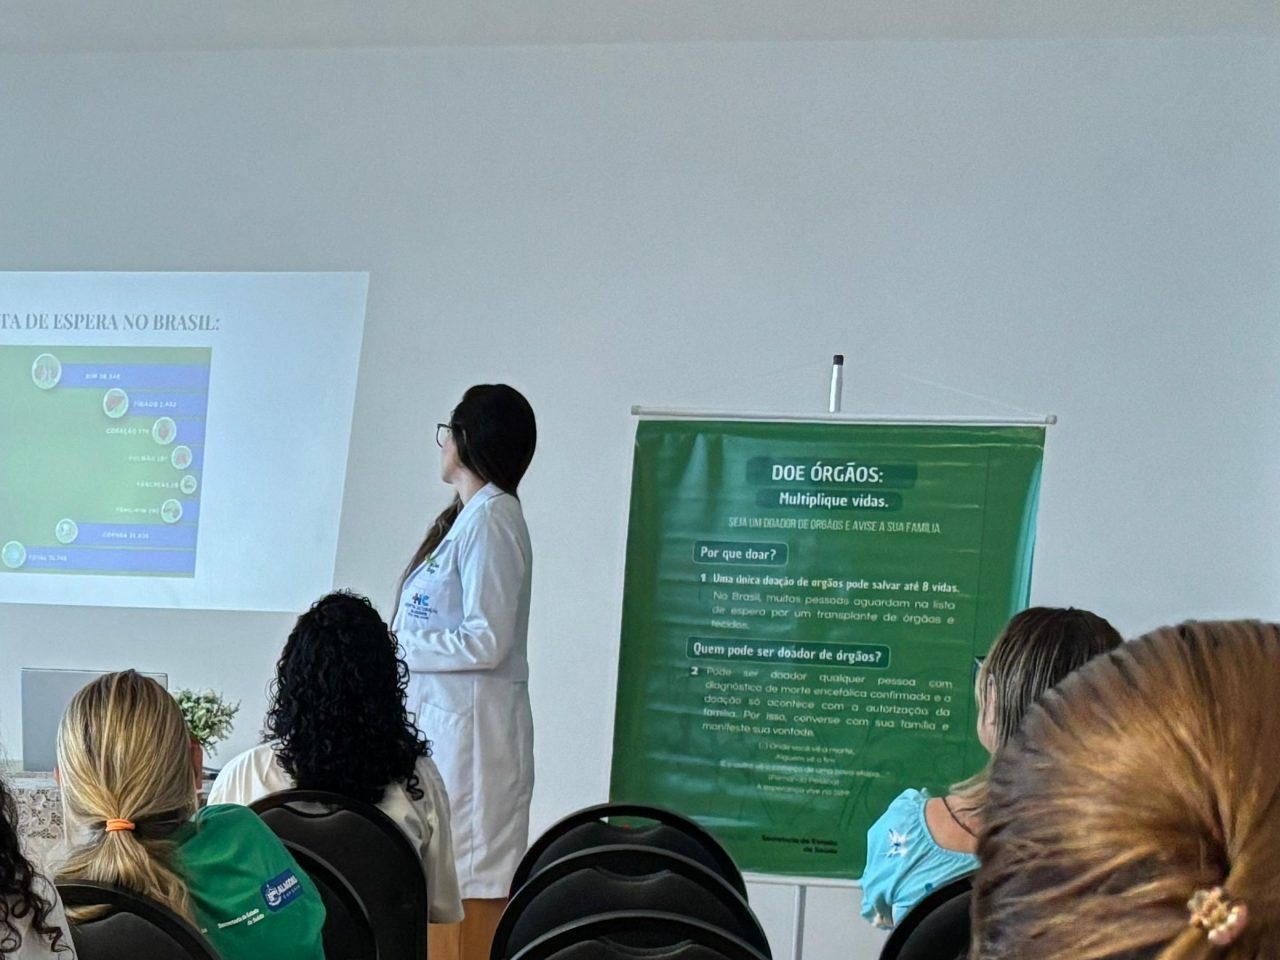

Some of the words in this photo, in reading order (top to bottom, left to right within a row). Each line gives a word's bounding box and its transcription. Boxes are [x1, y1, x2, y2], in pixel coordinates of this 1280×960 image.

[25, 313, 48, 330] DE
[53, 313, 118, 330] ESPERA
[122, 313, 149, 331] NO
[152, 314, 221, 331] BRASIL:
[771, 464, 806, 482] DOE
[810, 461, 884, 483] ÓRGÃOS:
[778, 491, 848, 509] Multiplique
[852, 494, 889, 508] vidas.
[728, 517, 748, 528] SEJA
[749, 518, 762, 528] UM
[763, 518, 796, 529] DOADOR
[797, 518, 809, 530] DE
[845, 520, 851, 531] E
[851, 520, 878, 532] AVISE
[878, 521, 885, 532] A
[886, 521, 905, 533] SUA
[700, 547, 719, 558] Por
[722, 549, 742, 561] que
[745, 548, 777, 561] doar?
[700, 573, 707, 582] 1
[713, 573, 733, 584] Uma
[736, 574, 761, 585] única
[763, 574, 794, 587] doação
[797, 576, 809, 587] de
[846, 579, 869, 591] pode
[872, 580, 901, 591] salvar
[903, 581, 919, 592] até
[922, 582, 929, 591] 8
[932, 582, 960, 593] vidas.
[713, 591, 728, 601] No
[766, 593, 801, 604] muitas
[805, 596, 850, 606] pessoas
[853, 597, 910, 608] aguardam
[914, 601, 929, 609] na
[933, 600, 956, 610] lista
[712, 606, 726, 615] de
[731, 608, 766, 618] espera
[771, 609, 789, 619] por
[794, 610, 811, 619] um
[817, 610, 878, 622] transplante
[883, 613, 897, 622] de
[947, 617, 955, 625] e
[693, 642, 724, 655] Quem
[727, 645, 754, 658] pode
[757, 647, 775, 658] ser
[777, 646, 816, 659] doador
[819, 648, 833, 660] de
[836, 649, 882, 664] órgãos?
[691, 666, 699, 676] 2
[706, 666, 732, 677] Pode
[743, 669, 759, 677] ser
[770, 670, 807, 681] doador
[819, 672, 865, 685] qualquer
[877, 676, 916, 687] pessoa
[929, 679, 953, 689] com
[705, 680, 762, 692] diagnóstico
[765, 684, 778, 694] de
[781, 685, 811, 695] morte
[813, 687, 867, 698] encefálica
[870, 690, 931, 702] confirmada
[934, 694, 941, 702] e
[944, 695, 952, 703] a
[704, 695, 742, 706] doação
[748, 697, 760, 706] só
[767, 698, 815, 709] acontece
[821, 701, 844, 711] com
[851, 704, 859, 712] a
[866, 704, 929, 716] autorização
[936, 707, 951, 717] da
[702, 722, 751, 733] manifeste
[752, 725, 771, 734] sua
[743, 710, 760, 719] Por
[793, 714, 840, 725] converse
[846, 717, 869, 726] com
[875, 719, 895, 728] sua
[942, 723, 949, 731] e
